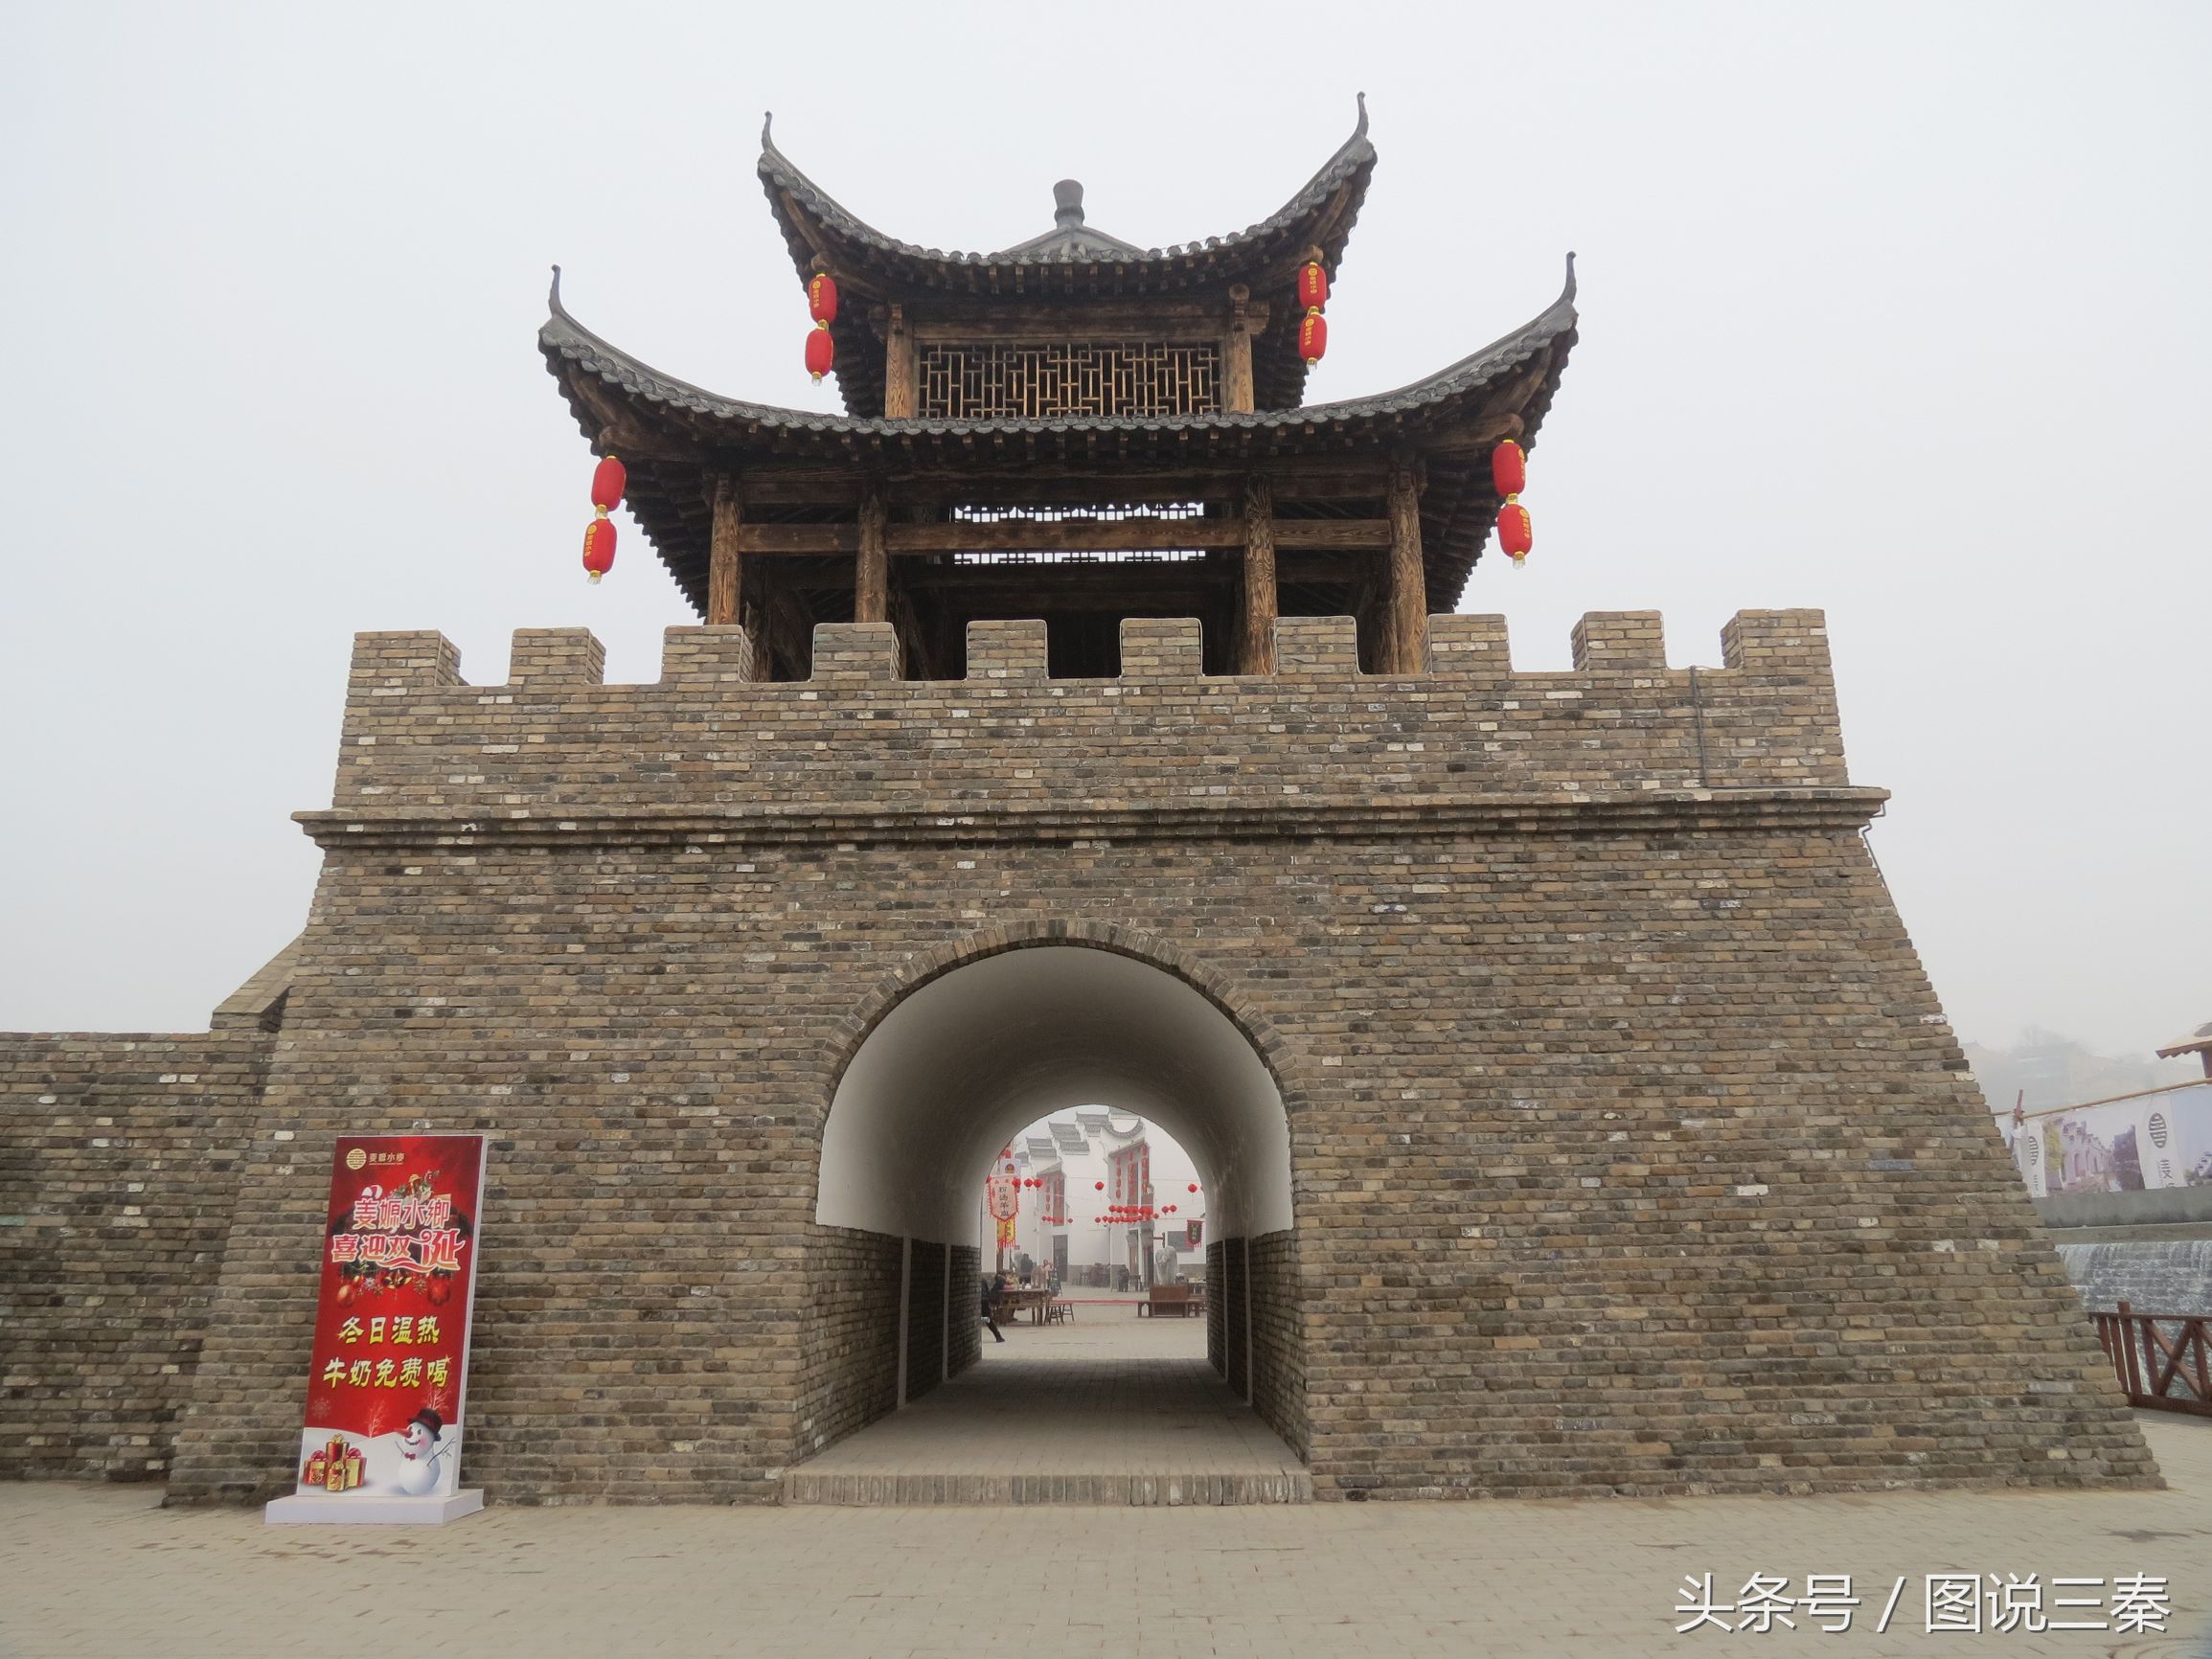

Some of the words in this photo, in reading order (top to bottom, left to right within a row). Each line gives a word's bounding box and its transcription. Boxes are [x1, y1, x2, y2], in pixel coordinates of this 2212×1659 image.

[331, 1229, 466, 1273] 喜迎双诞
[337, 1315, 440, 1345] 冬日温热
[323, 1356, 448, 1389] 牛奶免费喝
